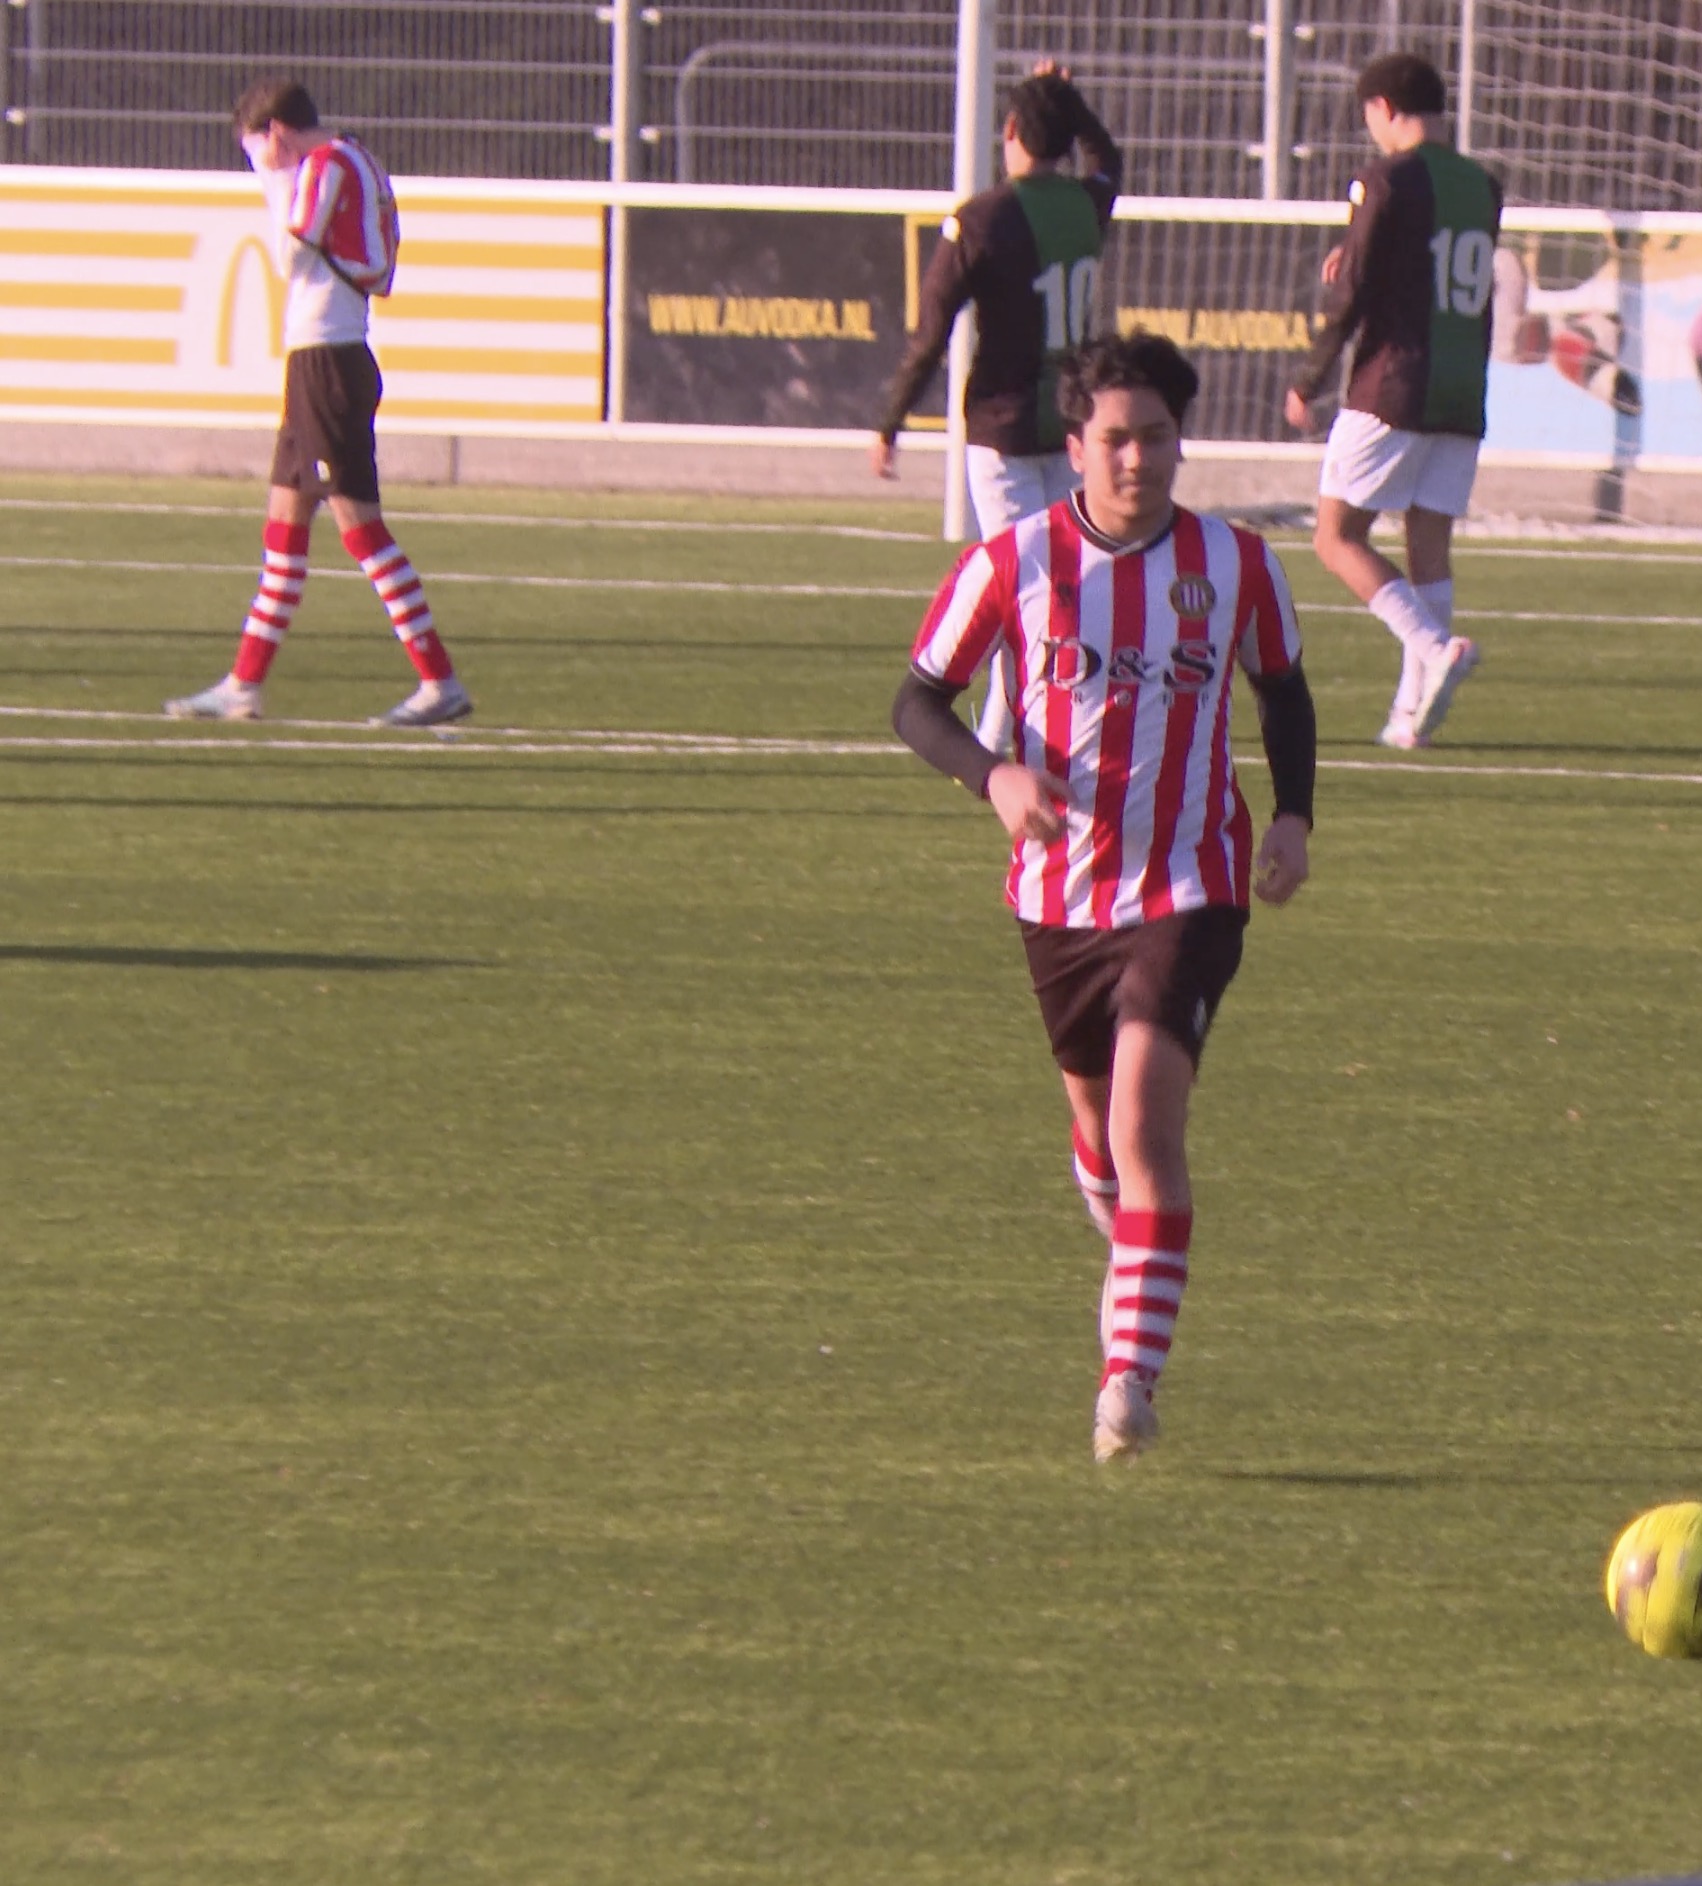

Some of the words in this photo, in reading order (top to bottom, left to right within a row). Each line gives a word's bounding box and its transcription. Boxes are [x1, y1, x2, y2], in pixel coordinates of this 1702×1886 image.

[1031, 256, 1101, 350] 10
[1428, 227, 1493, 317] 19
[647, 293, 876, 342] WWW.AUVODKA.NL
